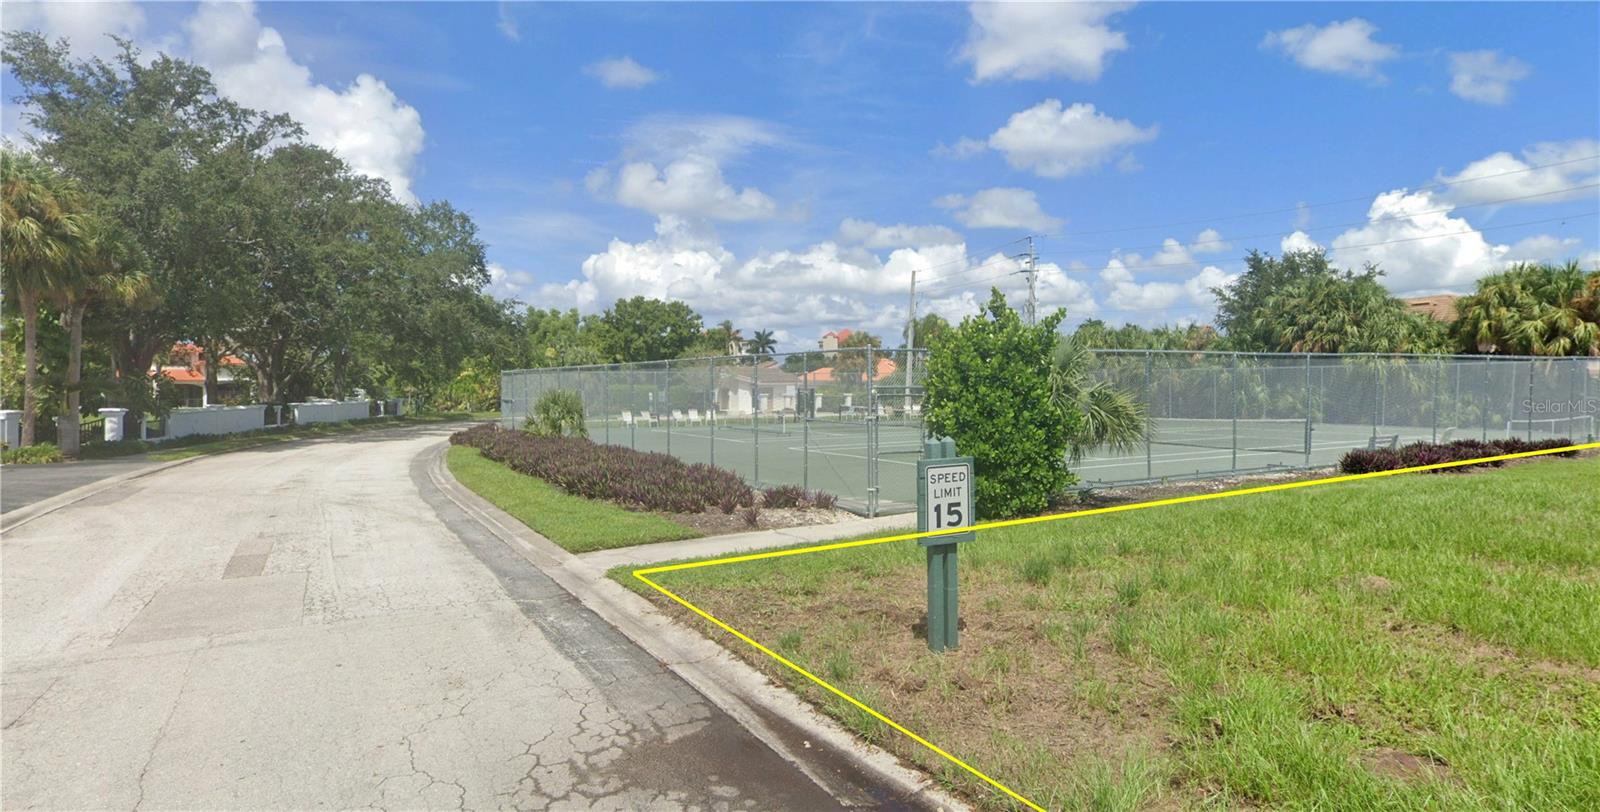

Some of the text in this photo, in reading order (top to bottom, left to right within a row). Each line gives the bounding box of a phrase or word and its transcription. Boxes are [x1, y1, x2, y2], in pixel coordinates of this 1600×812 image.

[930, 472, 966, 484] SPEED
[933, 487, 962, 499] LIMIT
[934, 502, 963, 528] 15
